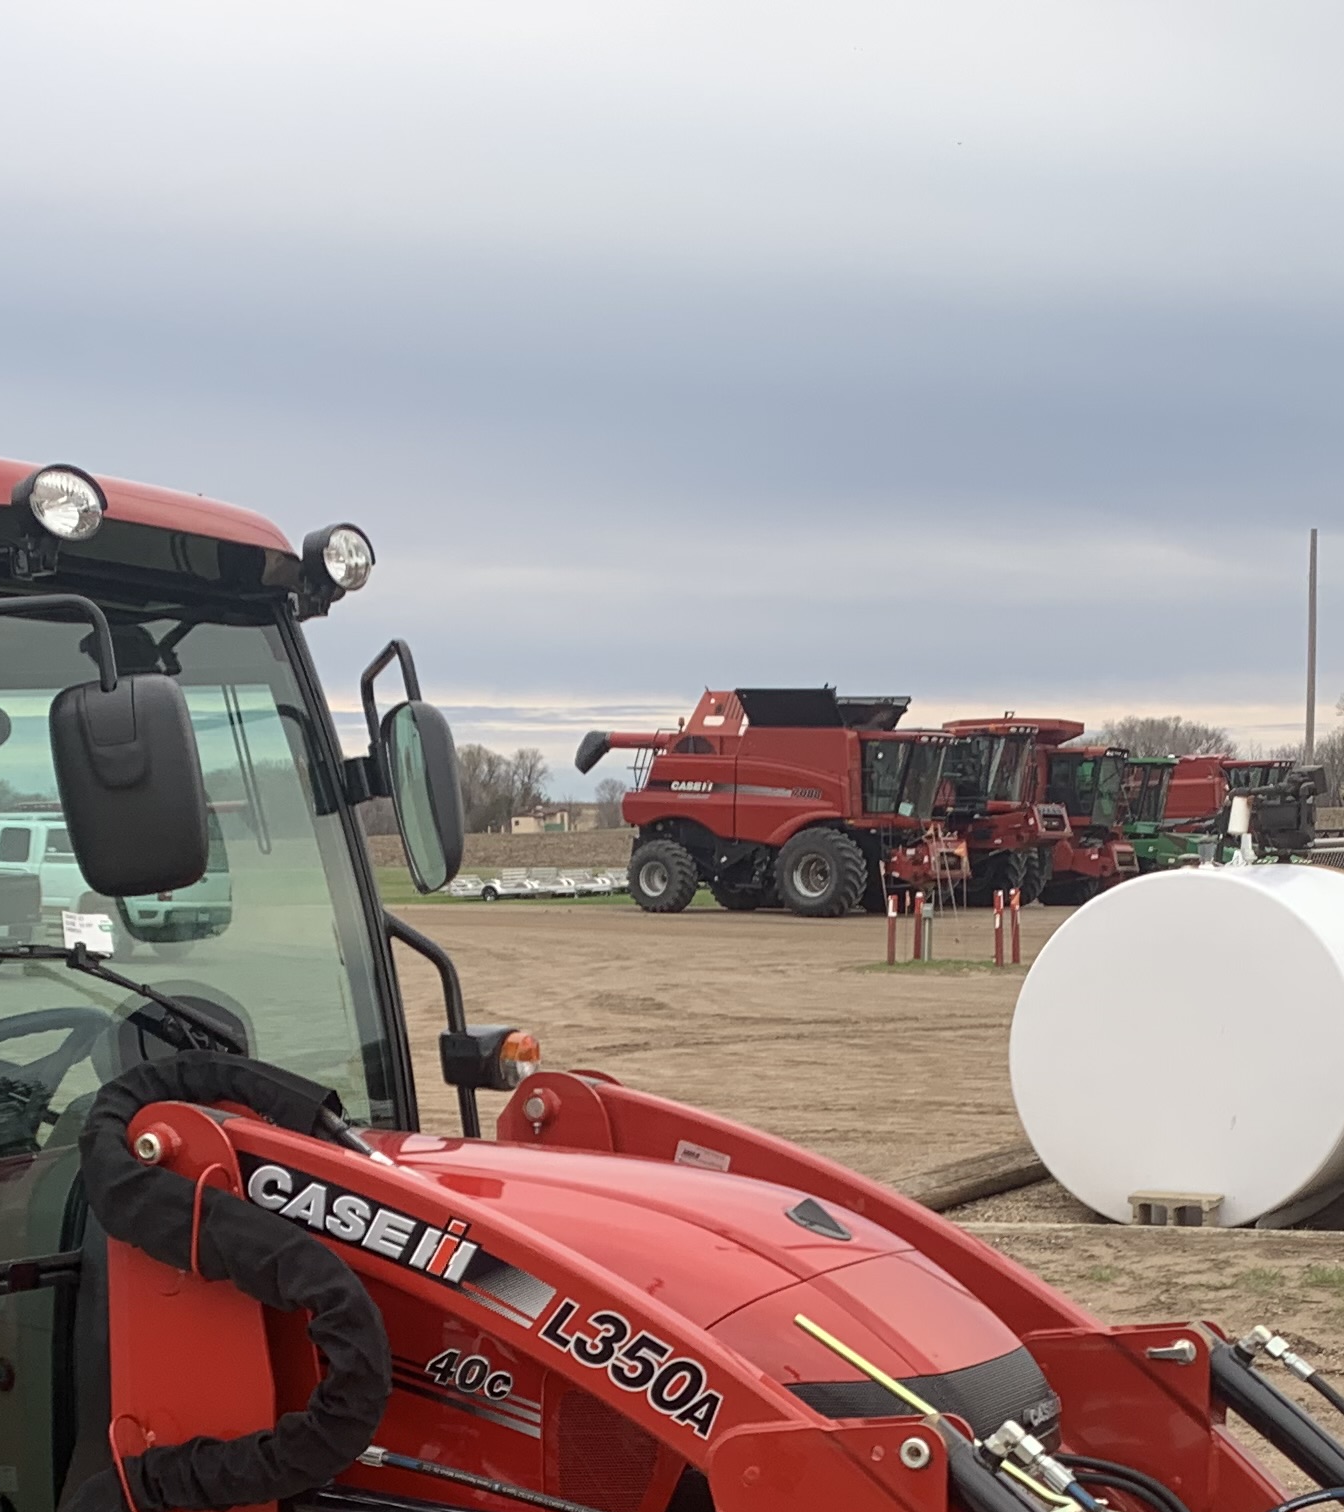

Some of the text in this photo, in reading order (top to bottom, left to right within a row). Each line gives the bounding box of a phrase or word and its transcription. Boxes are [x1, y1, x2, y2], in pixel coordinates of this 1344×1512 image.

[670, 780, 701, 792] CASE
[247, 1164, 417, 1261] CASE
[537, 1296, 724, 1441] L350A
